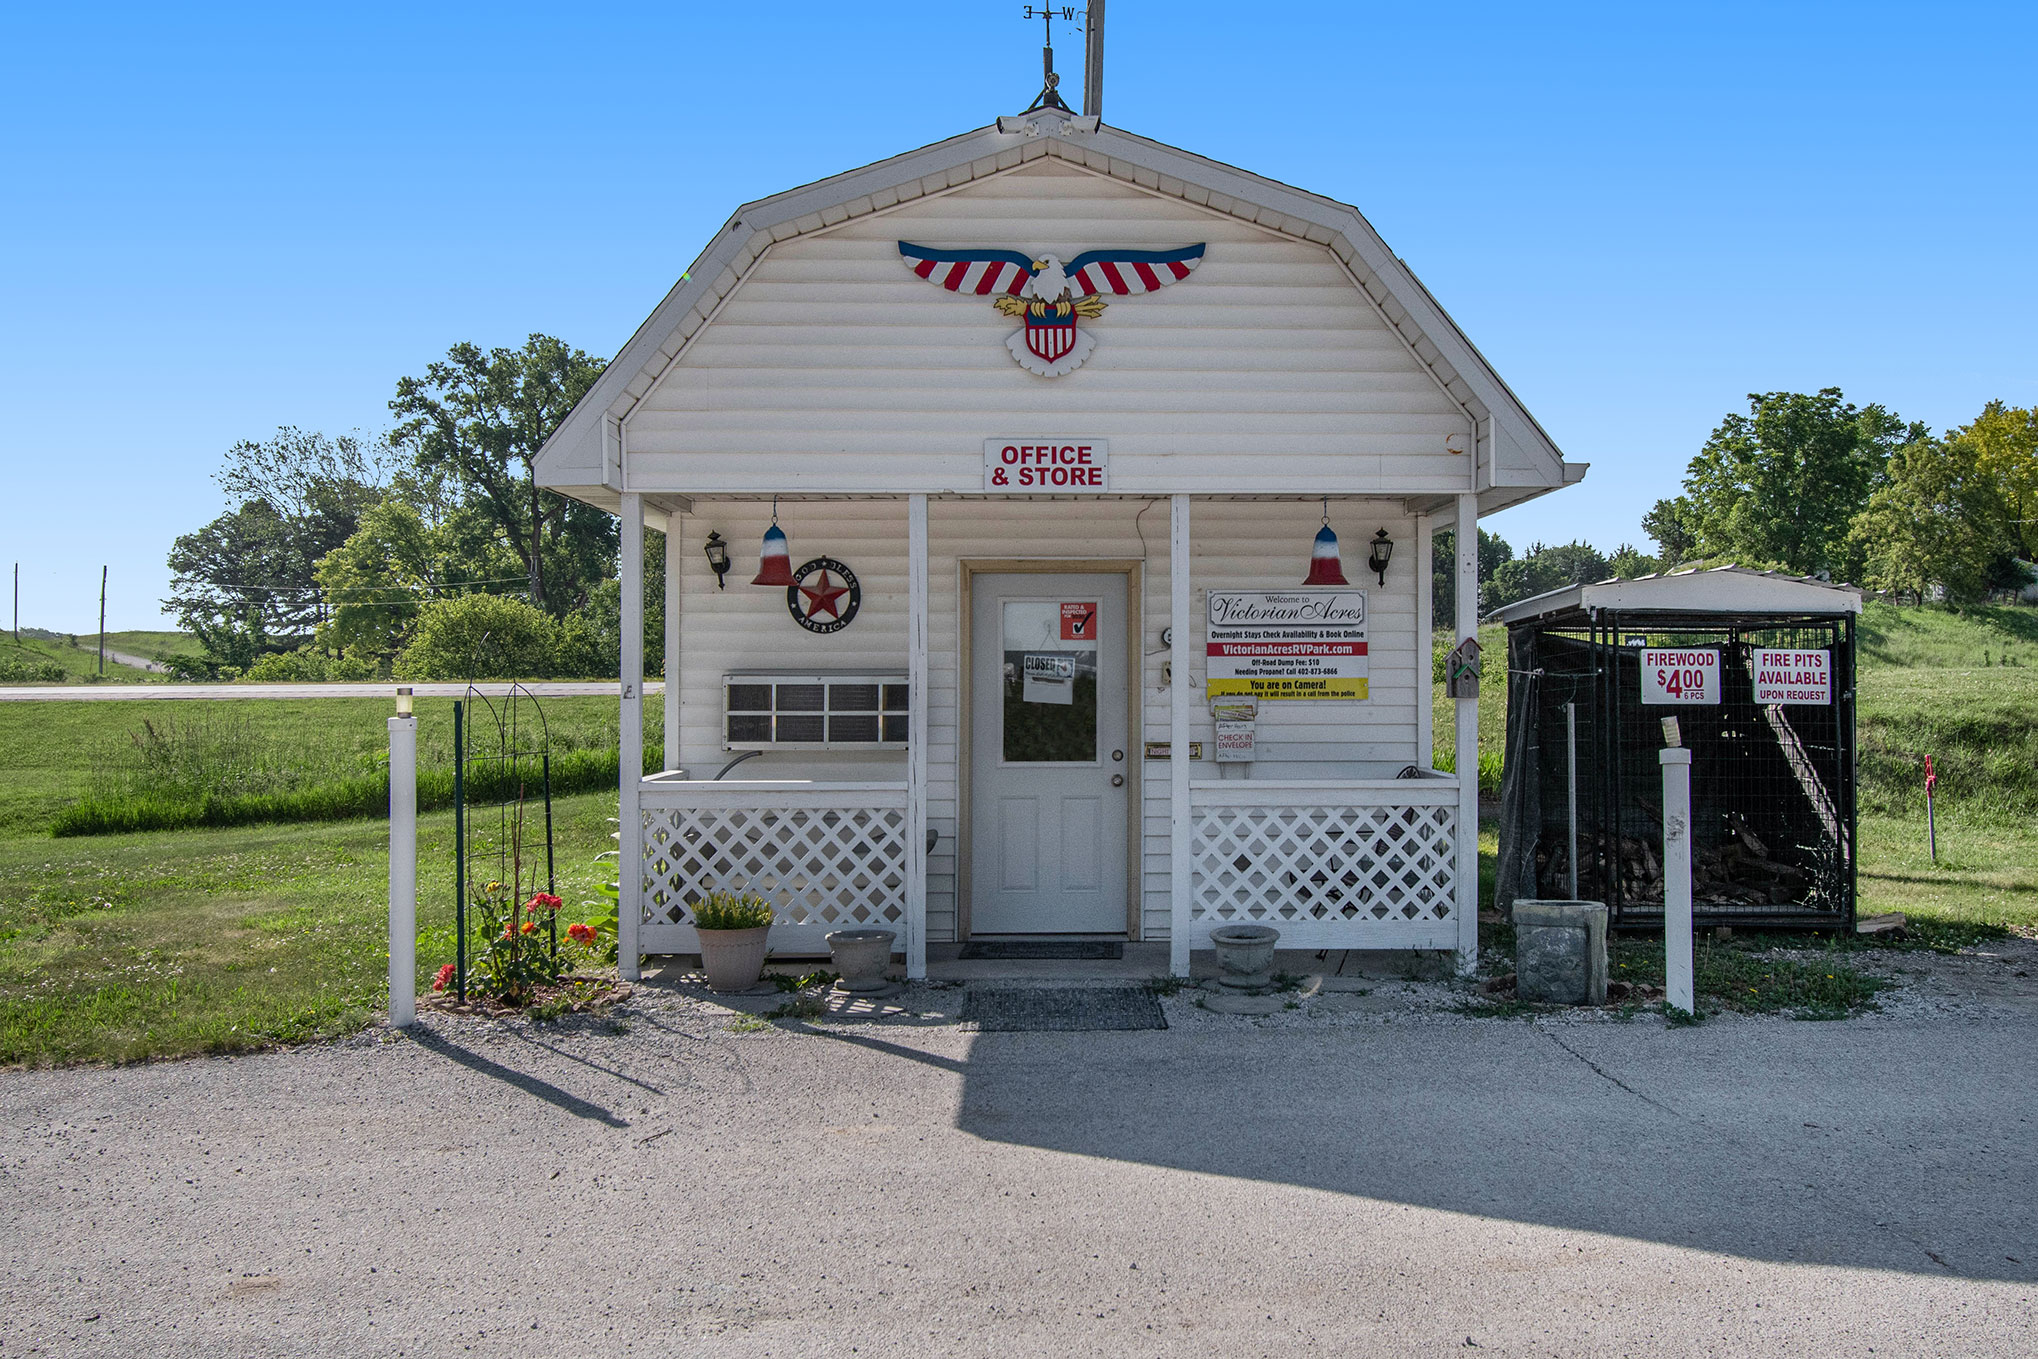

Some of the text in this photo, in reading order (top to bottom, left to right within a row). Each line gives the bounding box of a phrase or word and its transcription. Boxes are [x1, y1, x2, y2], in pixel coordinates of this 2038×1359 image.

[1062, 6, 1075, 21] W
[1001, 446, 1092, 464] OFFICE
[992, 467, 1102, 486] & STORE
[1266, 596, 1300, 604] Welcome
[1213, 596, 1362, 622] Victorian Acres
[798, 616, 847, 632] AMERICA
[1211, 630, 1243, 639] Overnight
[1244, 630, 1261, 639] Stays
[1282, 630, 1318, 639] Availability
[1222, 644, 1353, 655] VictorianAcresRVPark.com
[1025, 656, 1056, 671] CLOSED
[1278, 659, 1294, 667] Dump
[1647, 653, 1714, 667] FIREWOOD
[1763, 653, 1822, 667] FIRE PITS
[1250, 680, 1264, 689] You
[1294, 680, 1327, 690] Camera!
[1758, 671, 1827, 685] AVAILABLE
[1690, 692, 1705, 700] PCS
[1760, 690, 1826, 701] UPON REQUEST
